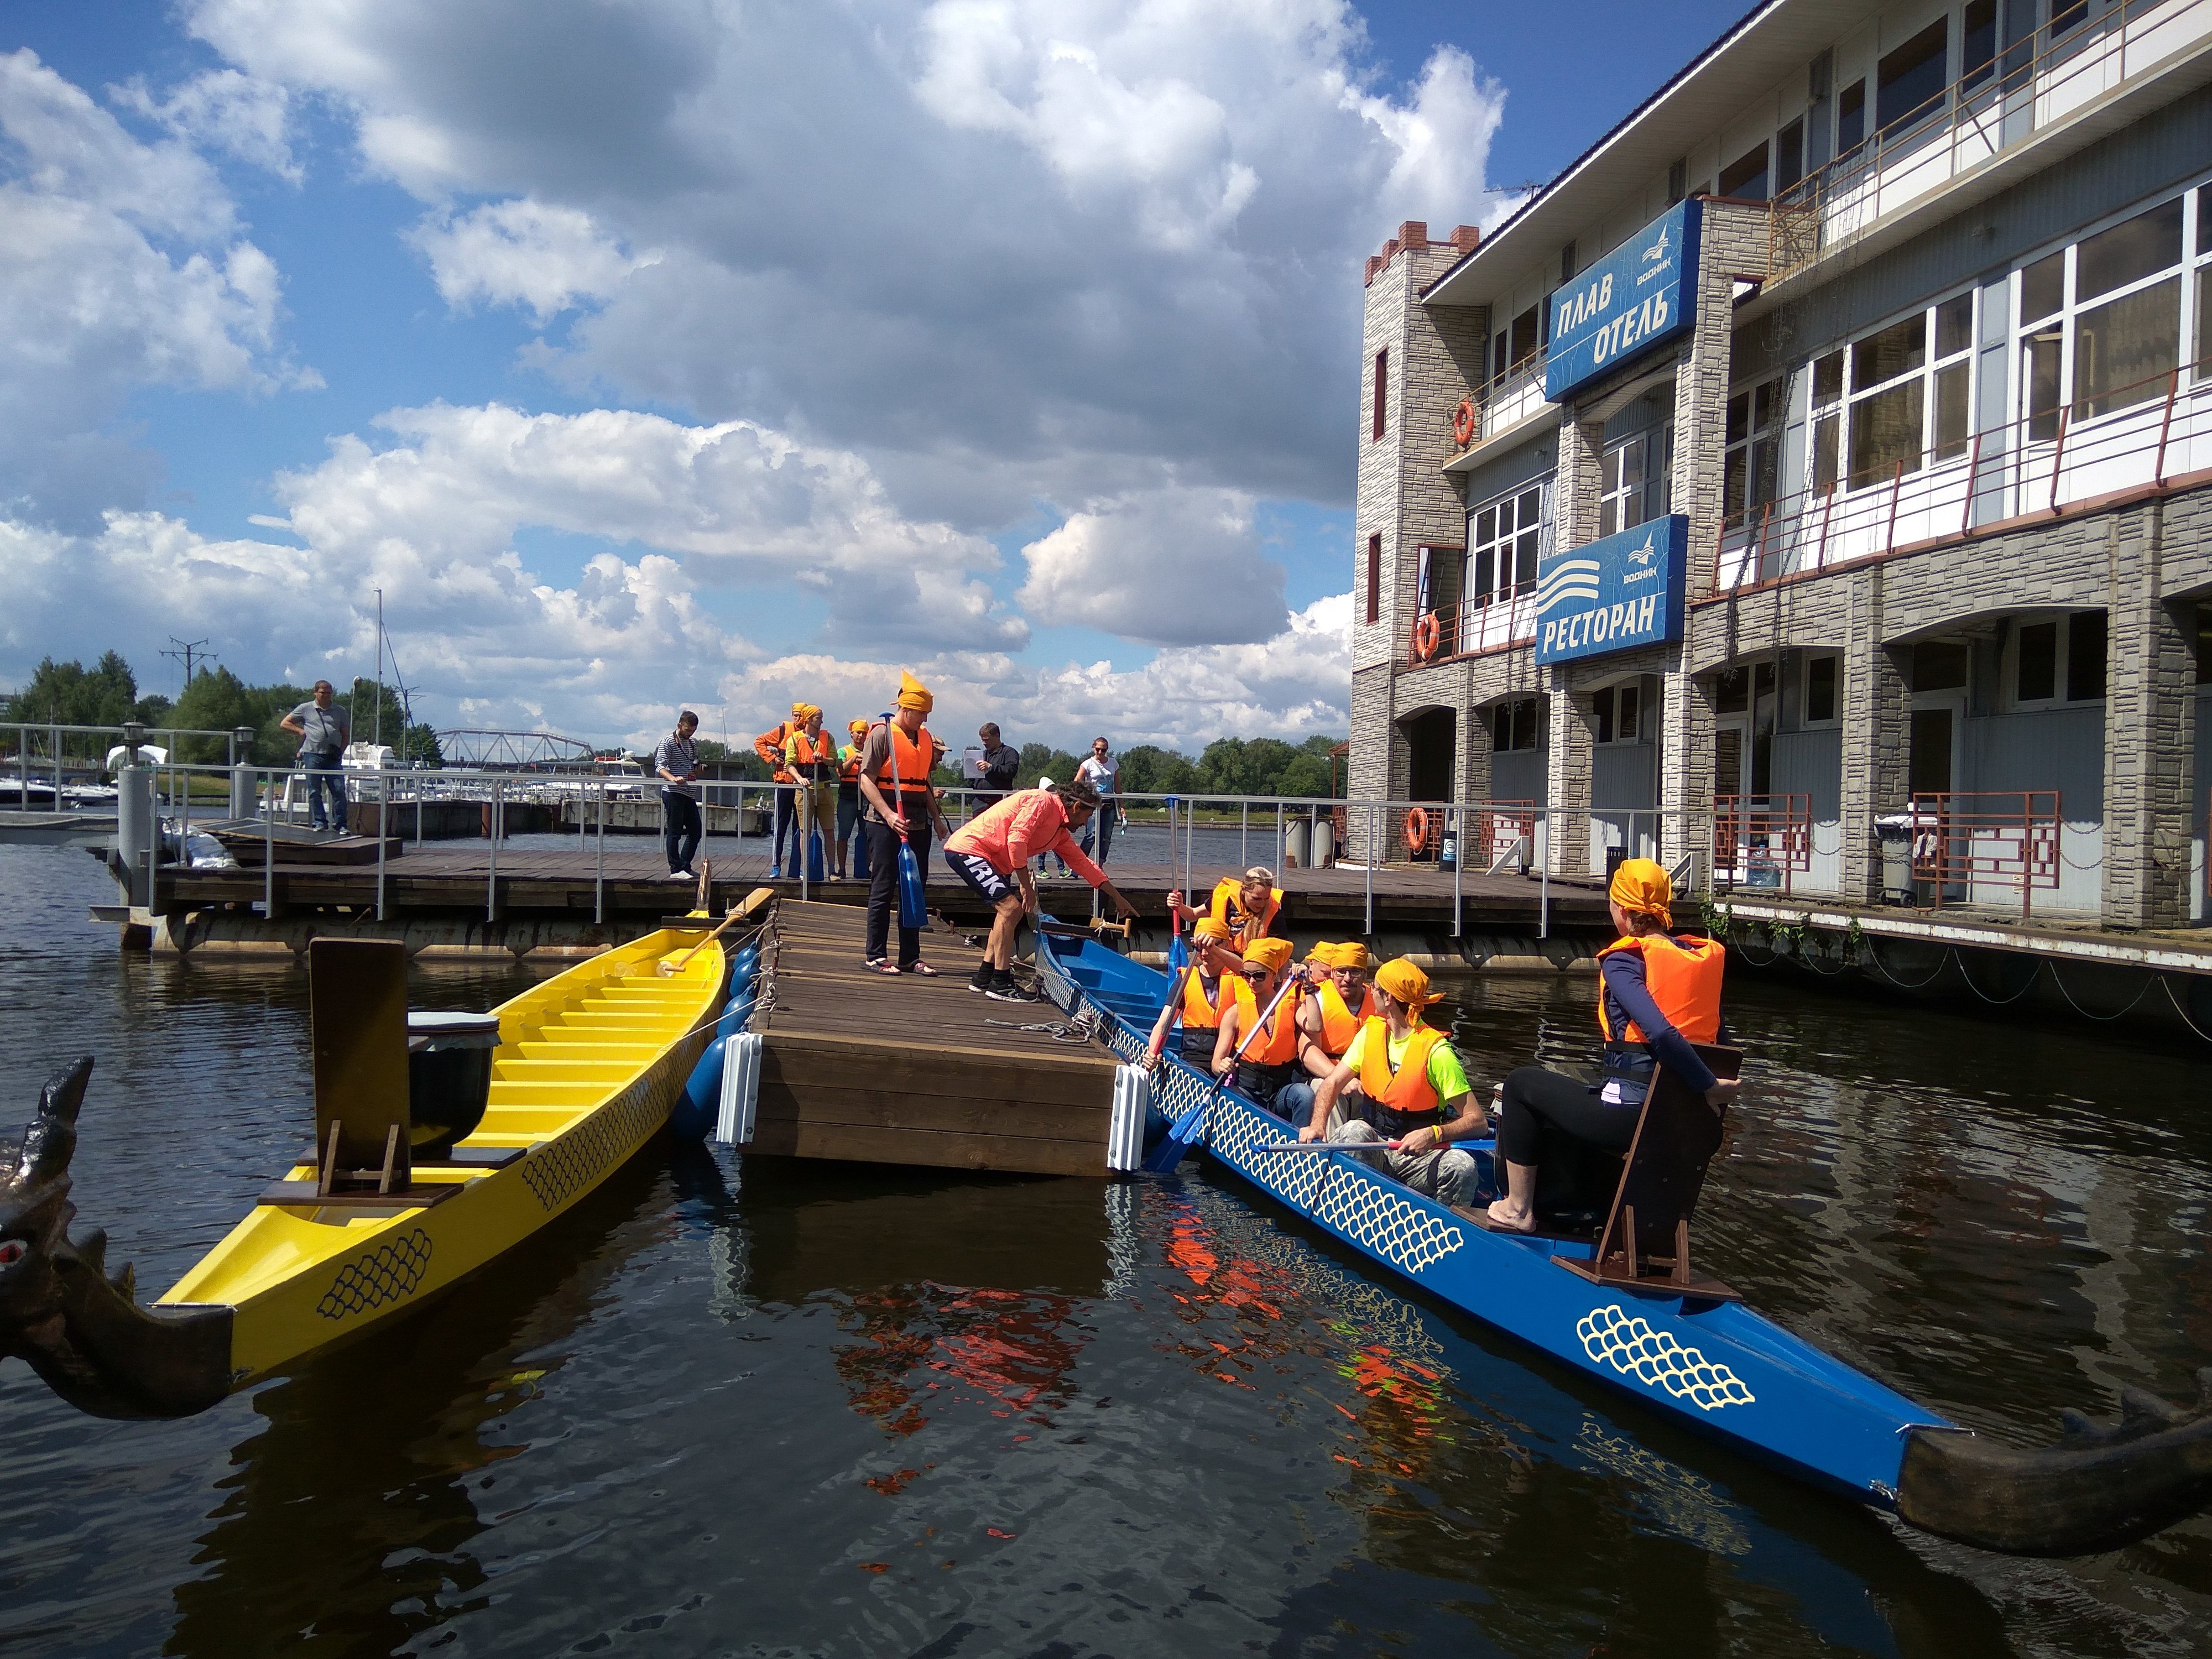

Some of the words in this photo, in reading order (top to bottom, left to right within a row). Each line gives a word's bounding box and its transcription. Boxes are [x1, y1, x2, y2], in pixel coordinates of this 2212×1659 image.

[1557, 273, 1613, 338] ПЛАВ
[1594, 290, 1668, 364] ОТЕЛЬ
[1542, 594, 1656, 654] РЕСТОРАН
